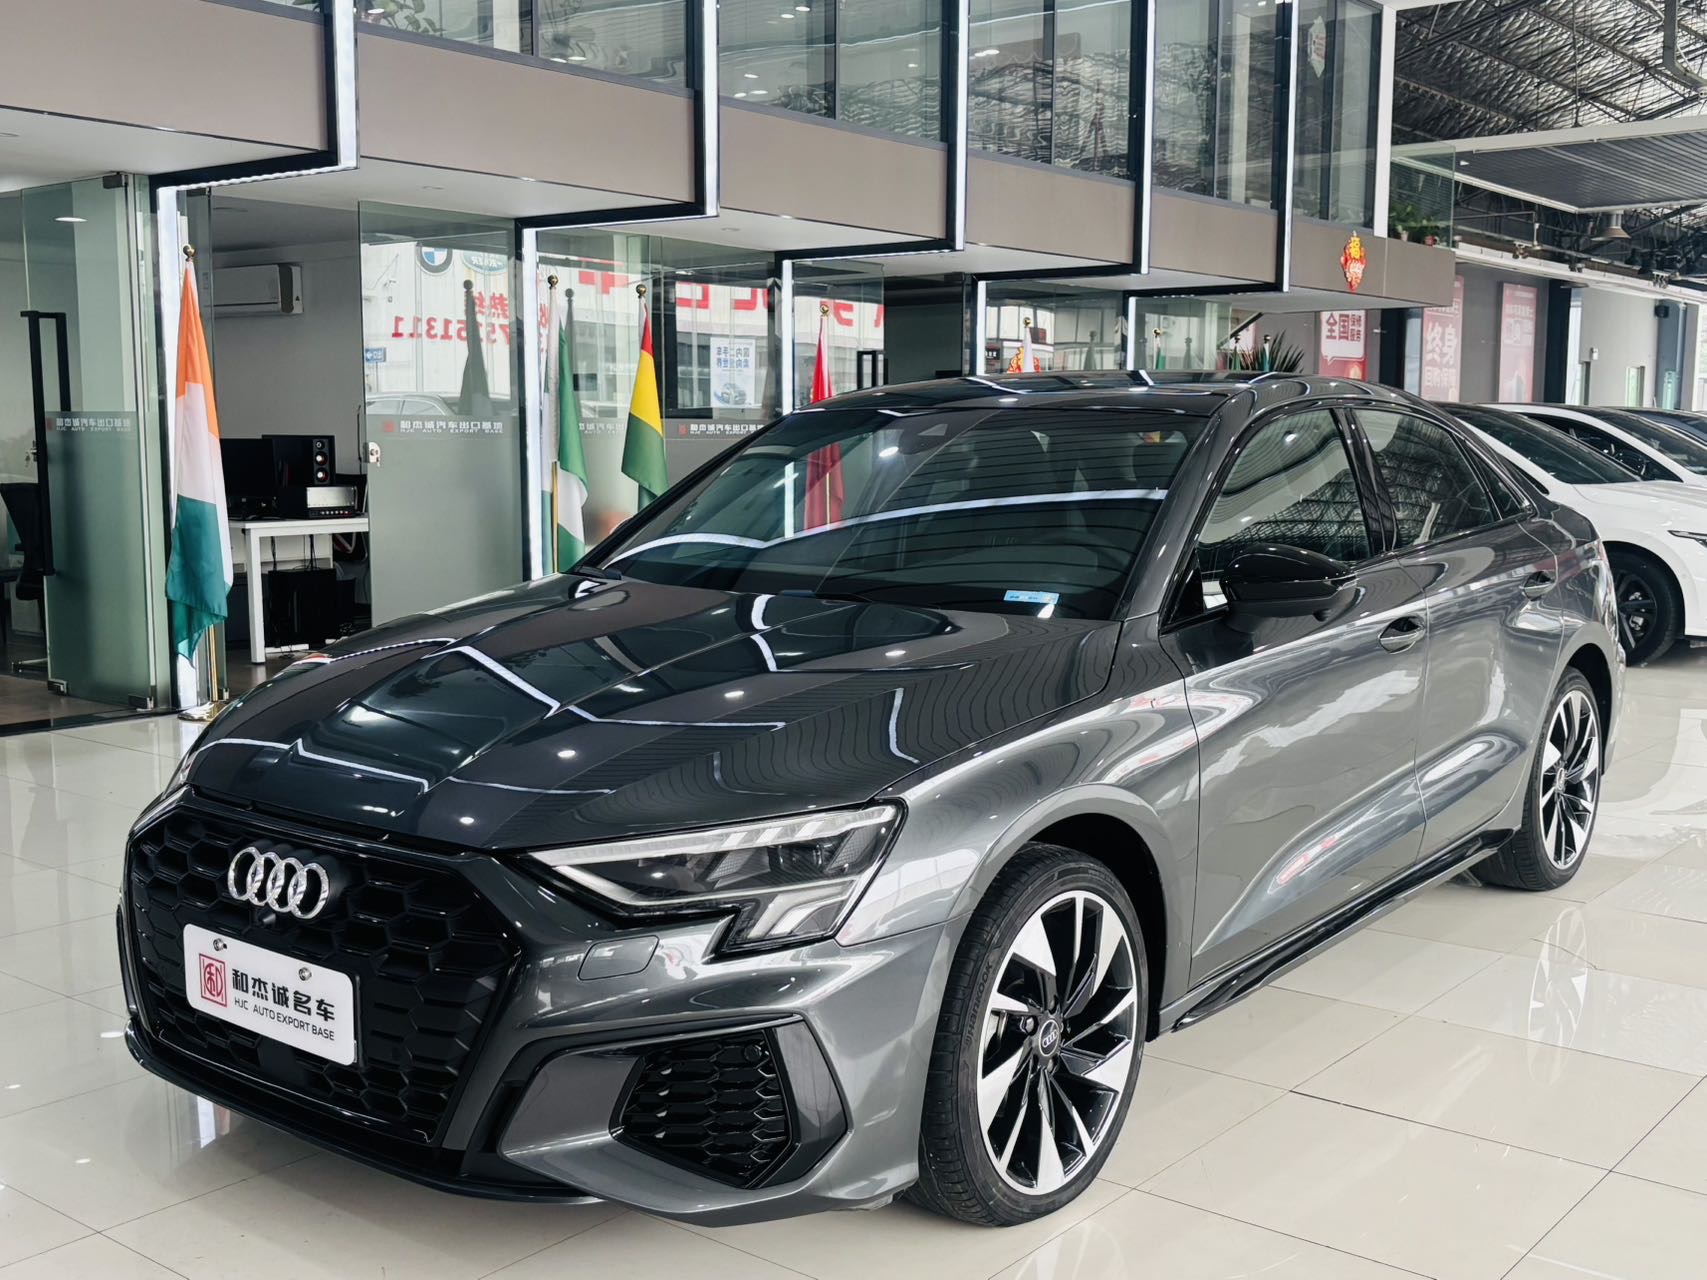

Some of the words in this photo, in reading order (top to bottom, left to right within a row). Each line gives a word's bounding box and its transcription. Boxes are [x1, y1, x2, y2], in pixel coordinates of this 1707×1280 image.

[232, 968, 335, 1022] 和杰诚名车
[234, 996, 249, 1011] HJC
[252, 1003, 276, 1020] AUTO
[276, 1011, 311, 1032] EXPORT
[311, 1023, 335, 1042] BASE
